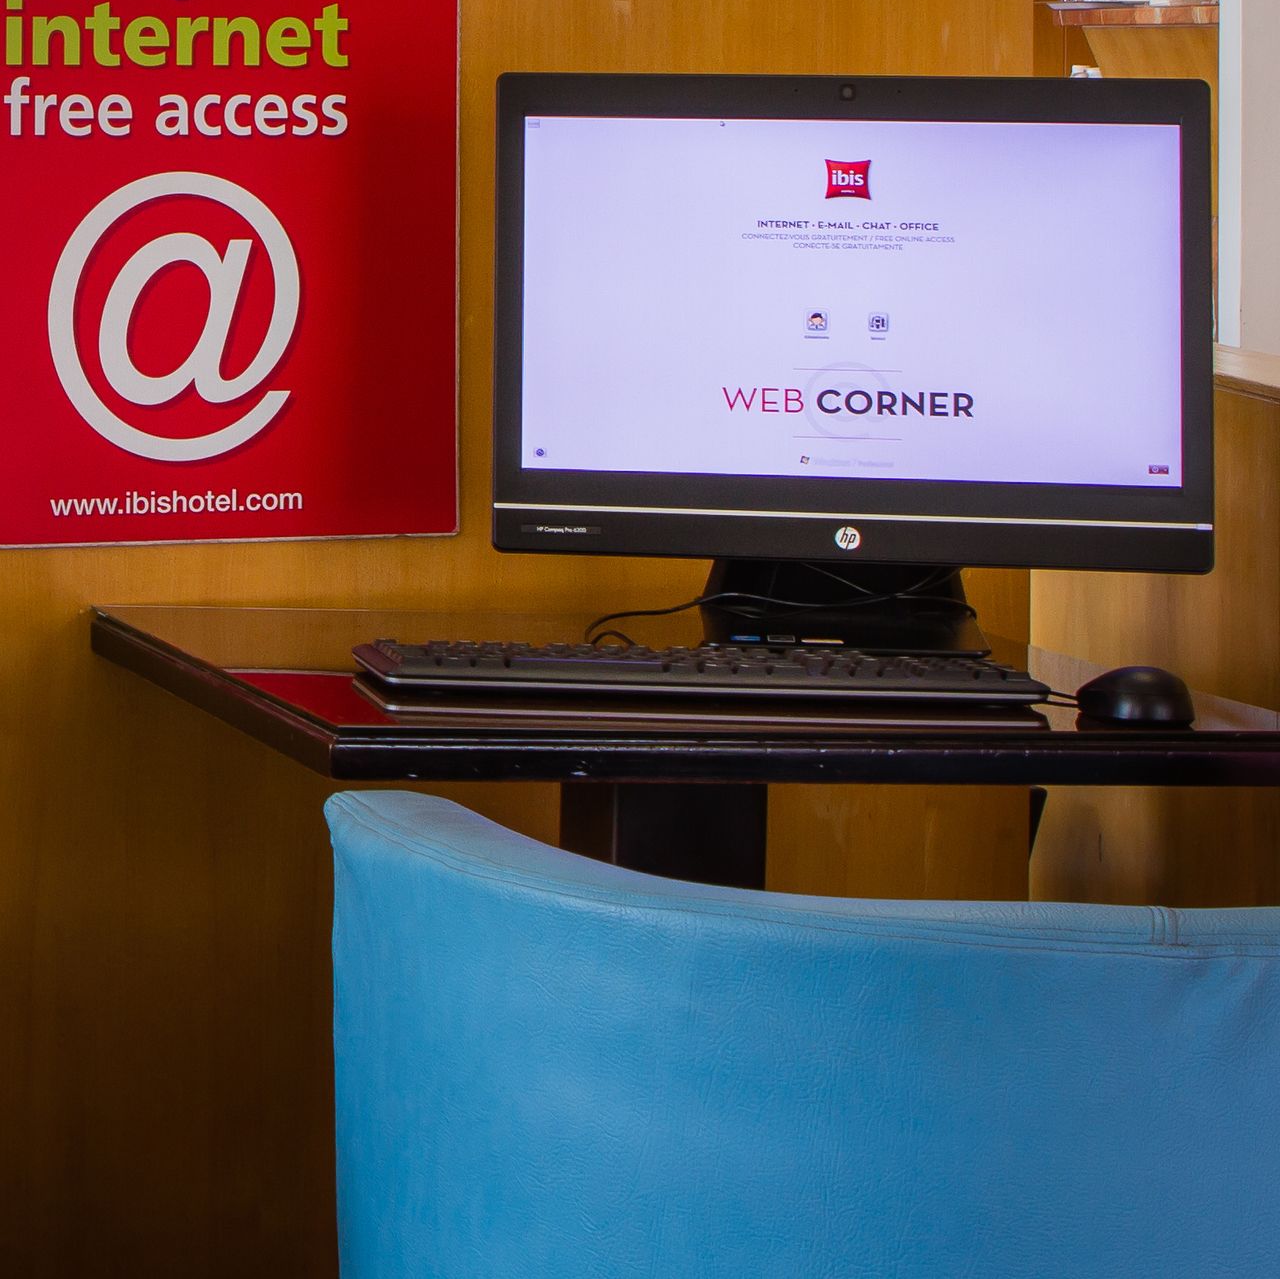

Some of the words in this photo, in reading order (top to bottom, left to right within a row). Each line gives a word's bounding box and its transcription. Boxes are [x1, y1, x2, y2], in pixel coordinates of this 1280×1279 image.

[3, 77, 133, 136] free
[155, 93, 348, 136] access
[831, 169, 865, 186] ibis
[757, 220, 810, 229] INTERNET
[817, 221, 854, 230] E-MAIL
[862, 221, 892, 230] CHAT
[899, 222, 940, 231] OFFICE
[721, 386, 805, 414] WEB
[816, 388, 975, 418] CORNER
[50, 488, 304, 517] www.ibishotel.com
